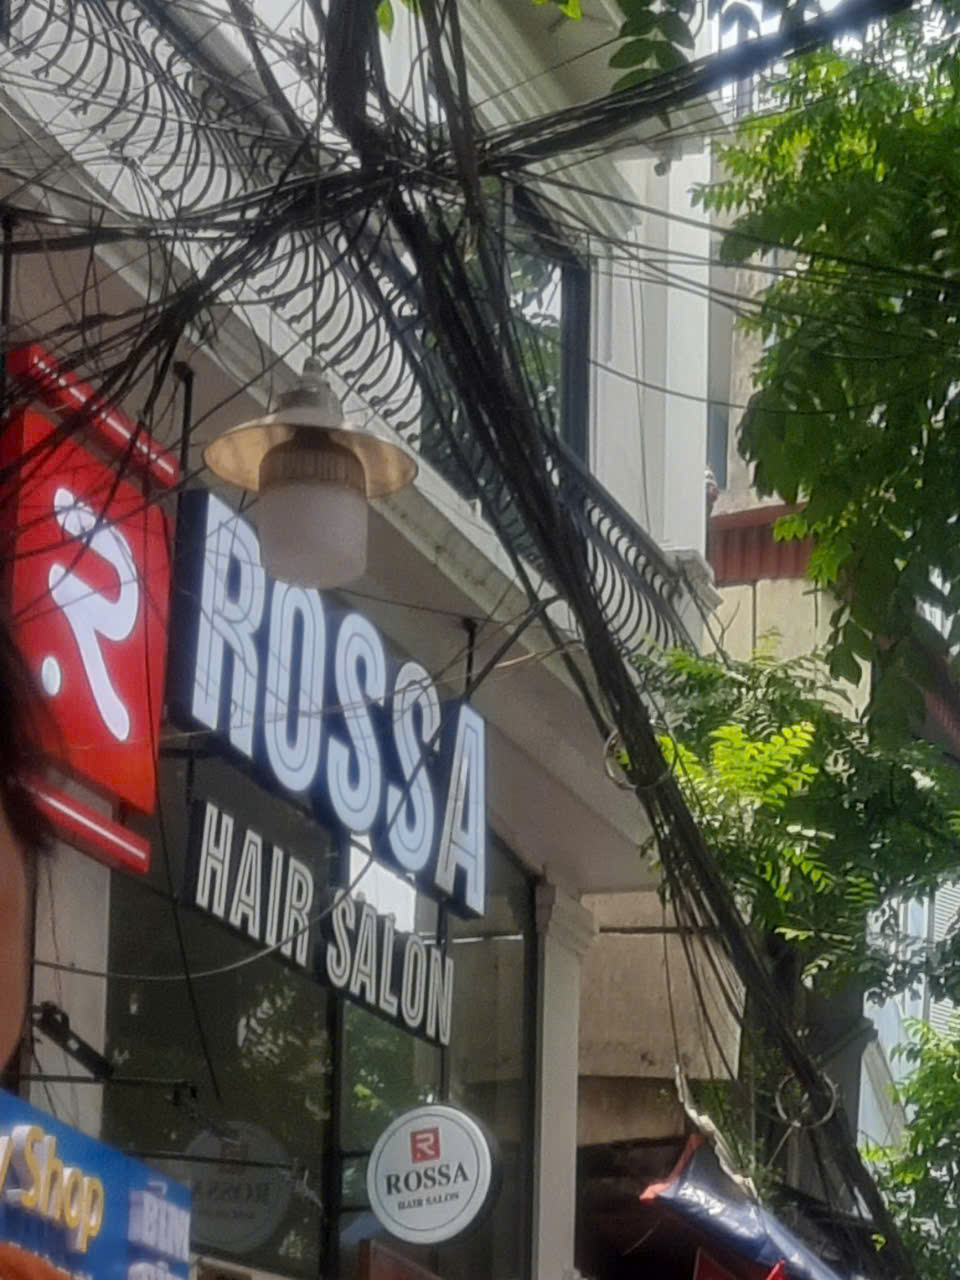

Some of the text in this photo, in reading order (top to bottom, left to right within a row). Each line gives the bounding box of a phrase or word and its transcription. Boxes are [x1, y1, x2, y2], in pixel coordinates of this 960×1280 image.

[191, 493, 484, 916] ROSSA
[194, 800, 455, 1047] HAIR SALON
[10, 1124, 105, 1253] Shop
[385, 1161, 470, 1197] ROSSA
[426, 1192, 460, 1205] SALON
